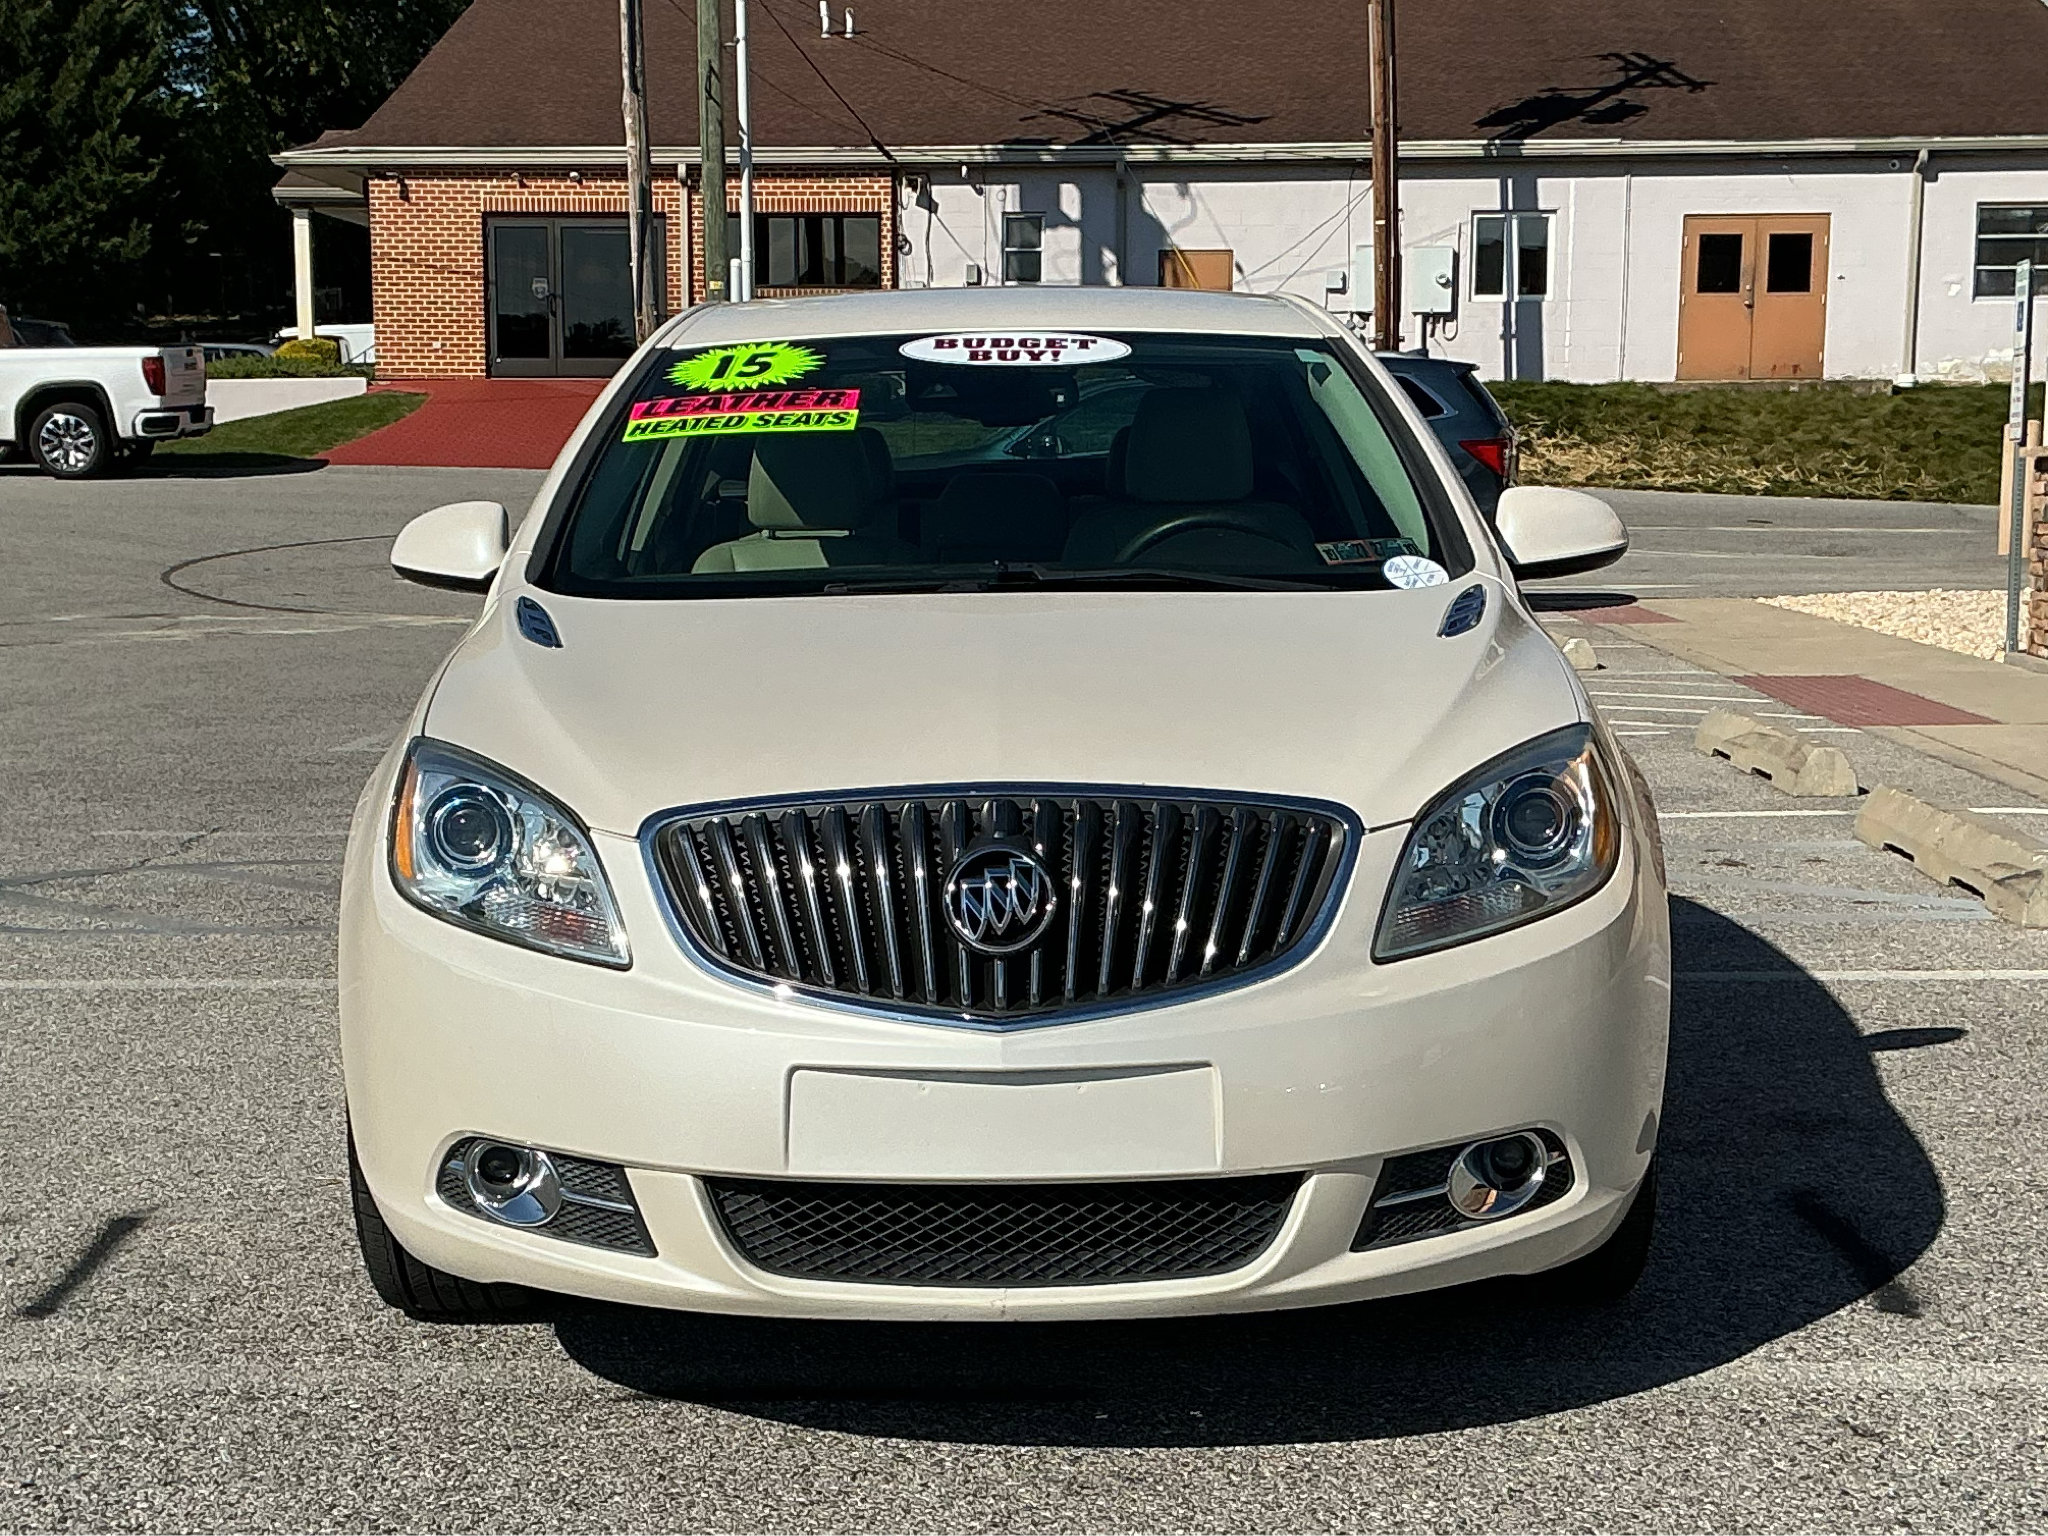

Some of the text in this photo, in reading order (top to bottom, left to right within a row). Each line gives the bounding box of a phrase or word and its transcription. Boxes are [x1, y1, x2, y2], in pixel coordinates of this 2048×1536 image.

[933, 337, 1098, 350] BUDGET
[967, 350, 1062, 363] BUY!
[710, 351, 778, 380] 15
[641, 390, 848, 417] LEATHER
[627, 410, 852, 437] HEATED SEATS
